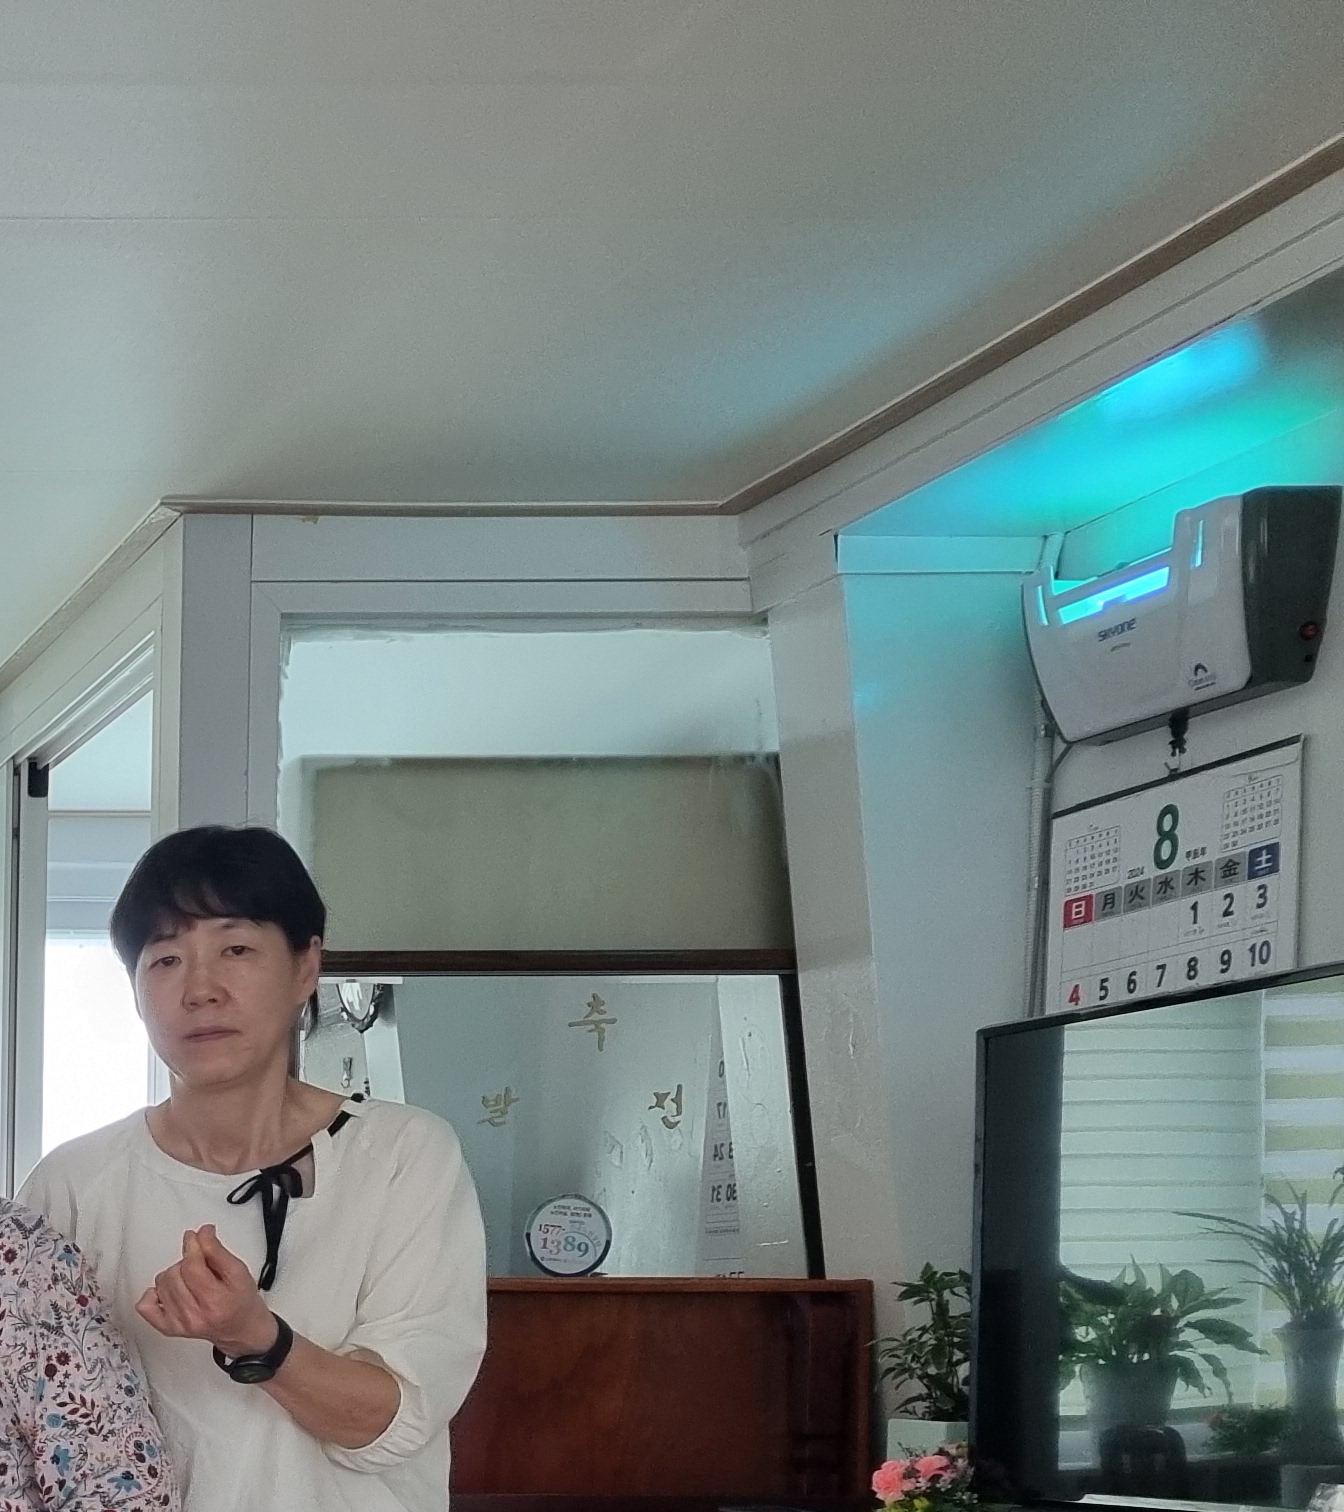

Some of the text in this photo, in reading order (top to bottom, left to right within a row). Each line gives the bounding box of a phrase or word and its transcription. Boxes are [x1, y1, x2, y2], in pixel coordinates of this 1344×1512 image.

[1153, 803, 1180, 870] 8
[1071, 849, 1273, 920] 日 月 火 水 木 金 土
[1190, 884, 1268, 924] 1 2 3
[1068, 940, 1271, 1006] 4 5 6 7 8 9 10
[568, 992, 618, 1052] 축
[477, 1083, 683, 1130] 발 전
[540, 1235, 589, 1258] 1389
